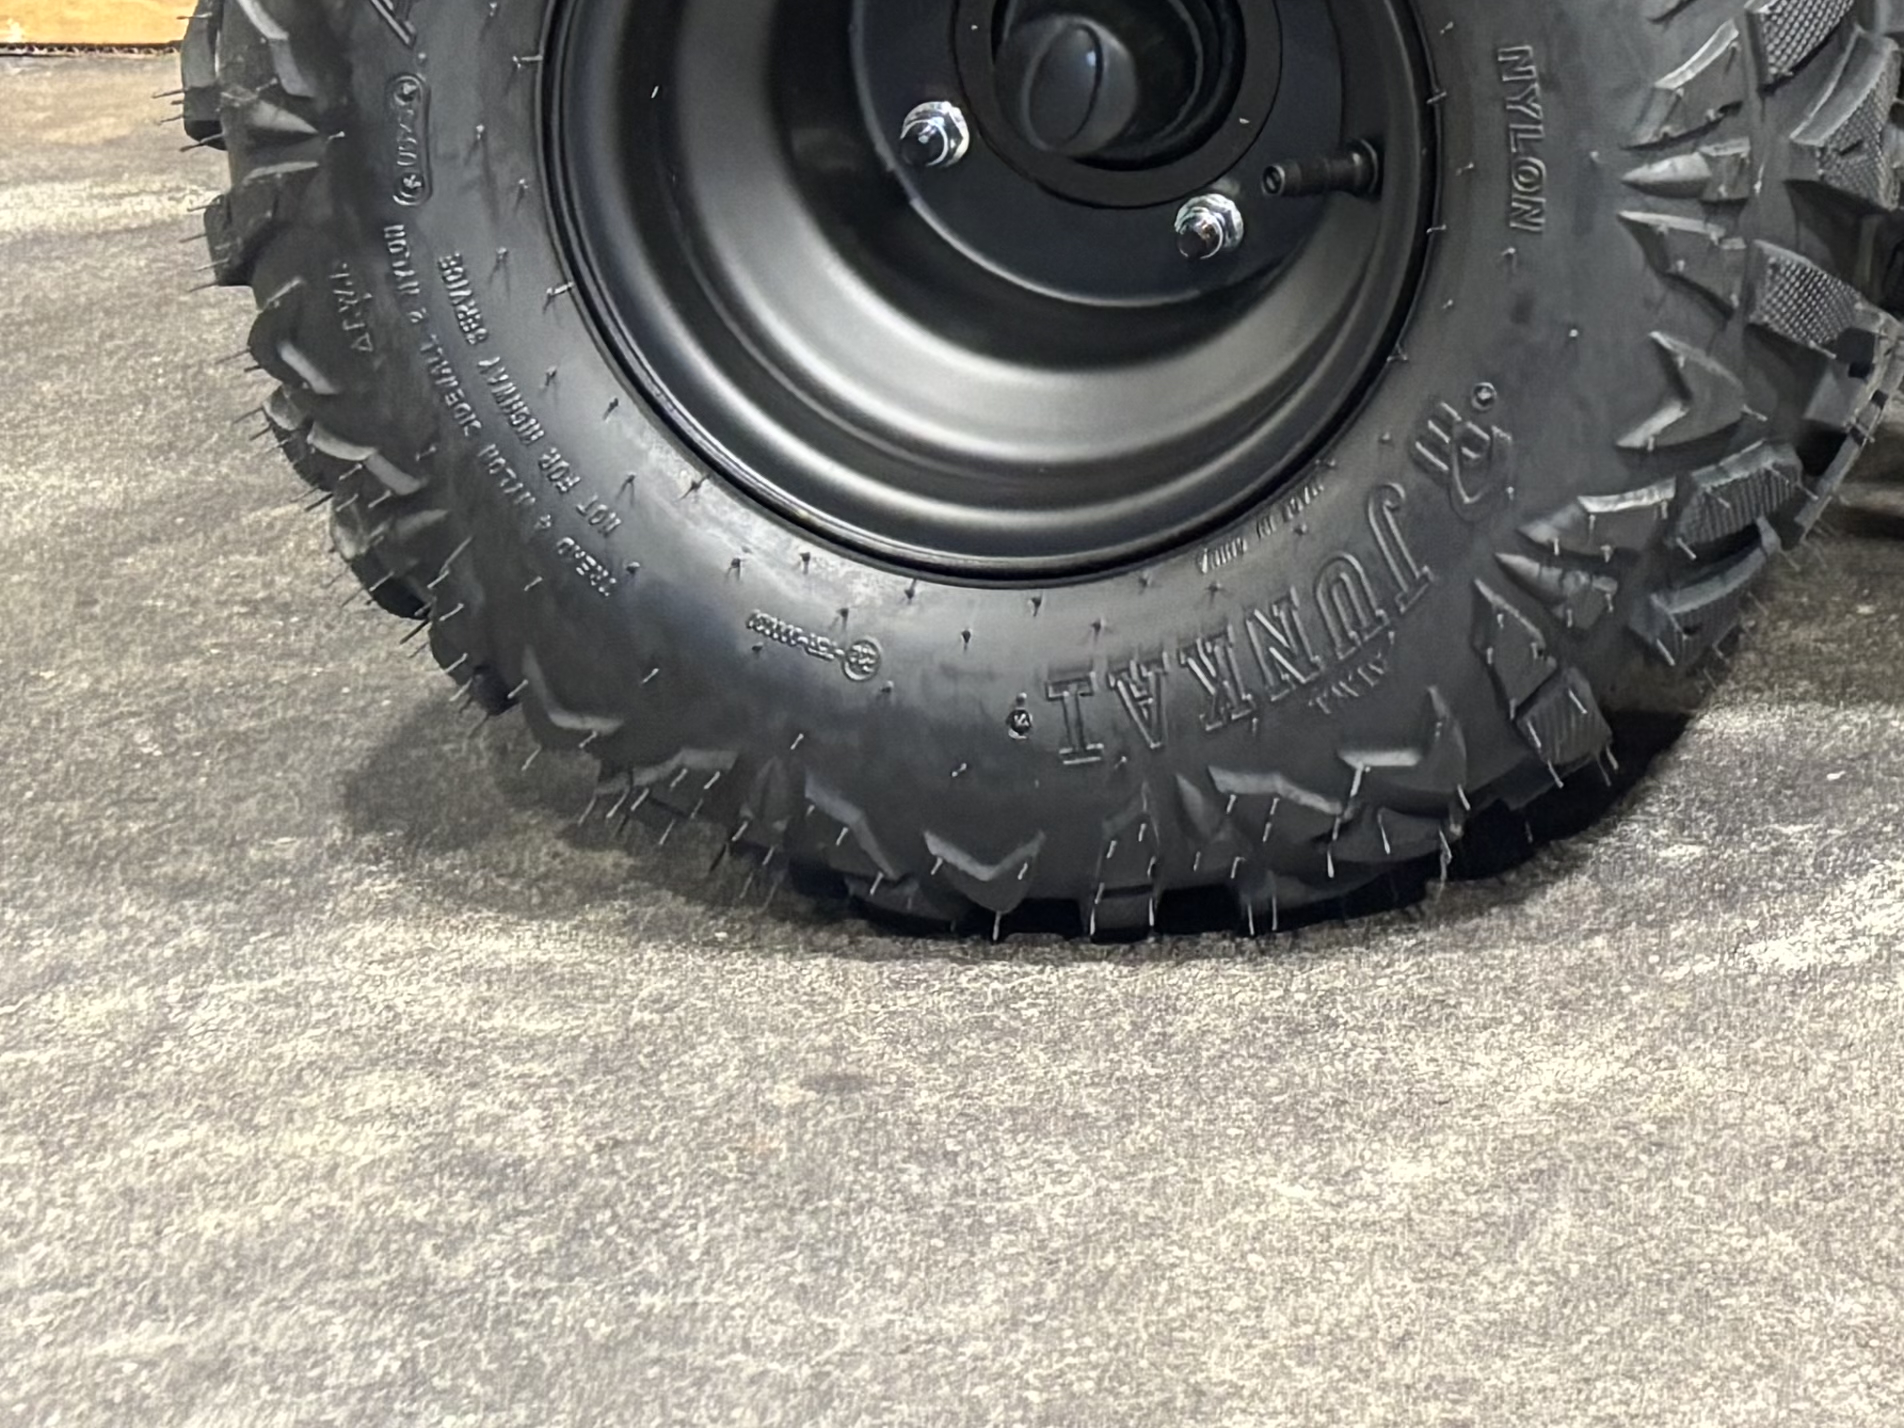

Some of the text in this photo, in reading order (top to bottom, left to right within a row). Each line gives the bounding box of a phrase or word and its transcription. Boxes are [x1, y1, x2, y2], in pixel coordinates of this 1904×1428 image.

[1497, 44, 1547, 235] NYLON
[438, 251, 488, 344] SERVICE
[478, 356, 544, 441] HIGHWAY
[537, 447, 581, 496] FOR
[1044, 482, 1435, 766] JUNKAI
